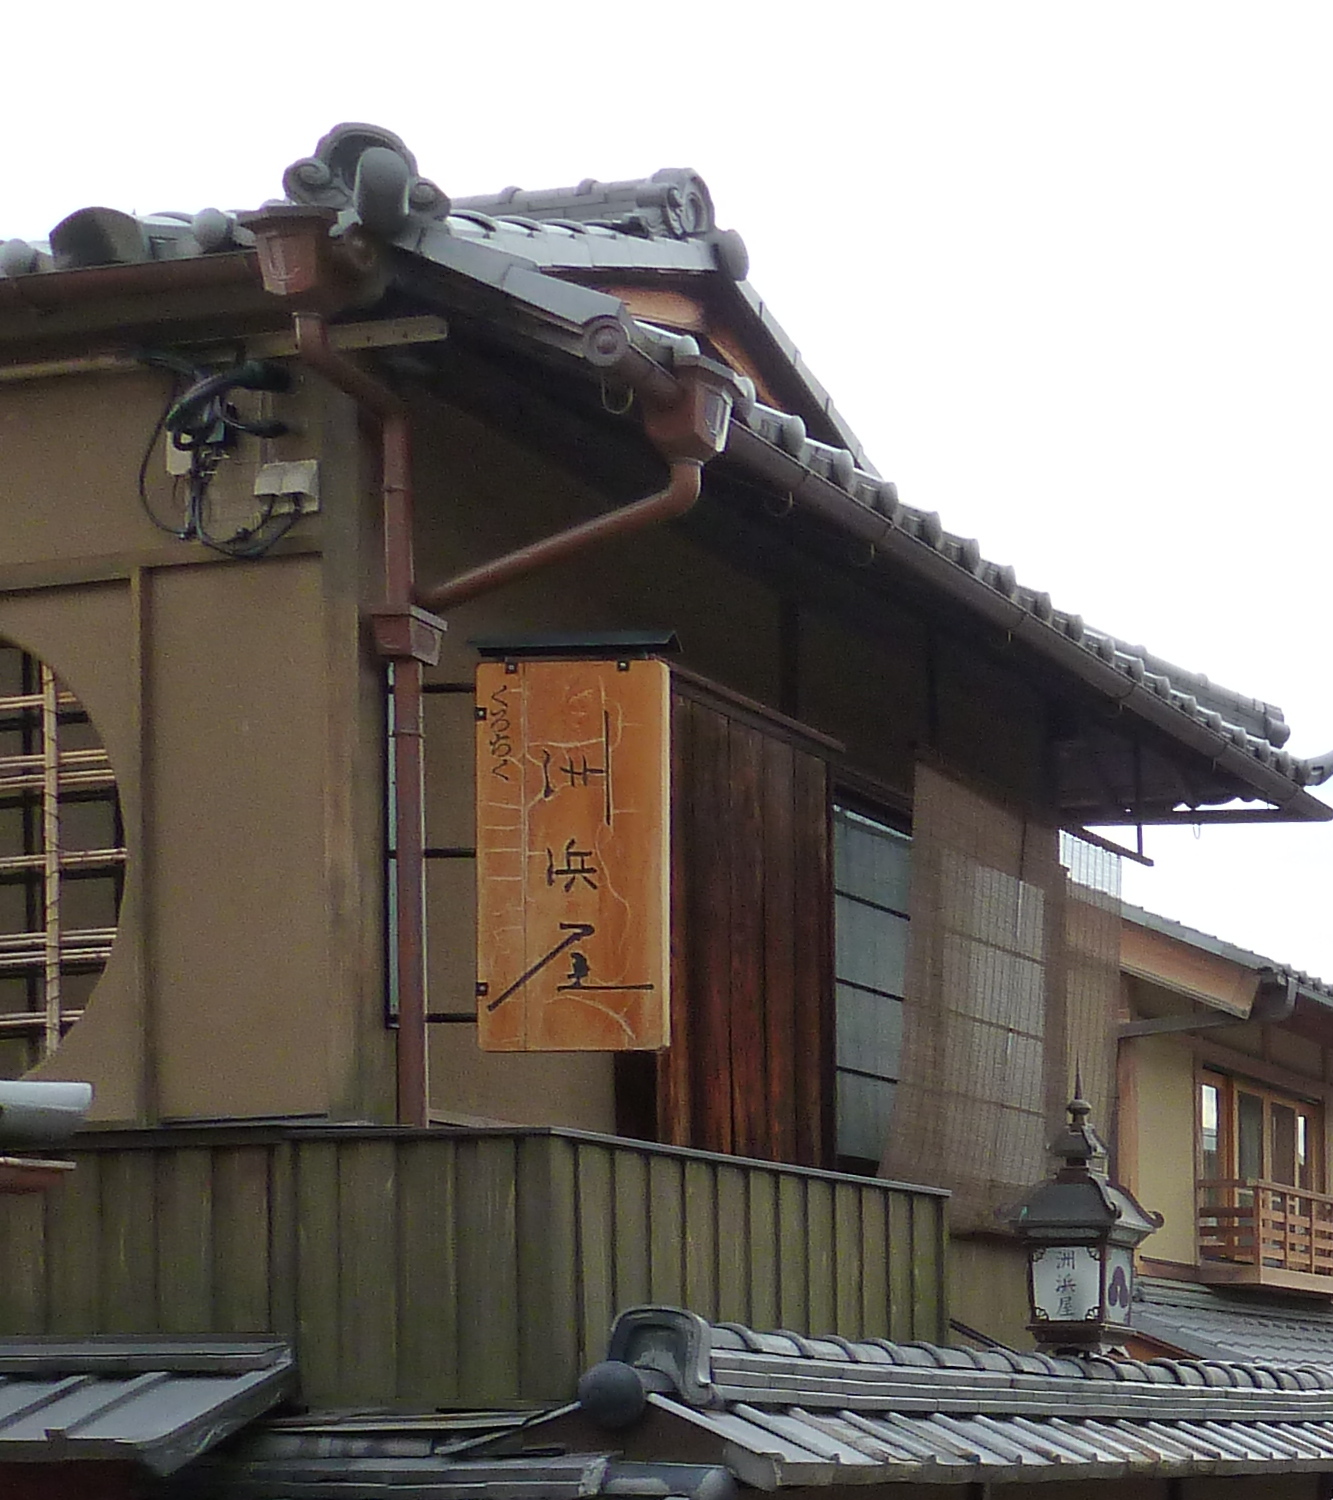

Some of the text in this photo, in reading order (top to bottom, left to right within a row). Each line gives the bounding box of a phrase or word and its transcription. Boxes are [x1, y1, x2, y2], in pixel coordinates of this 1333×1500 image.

[489, 684, 511, 782] くろちく
[1055, 1249, 1078, 1318] 洲浜屋
